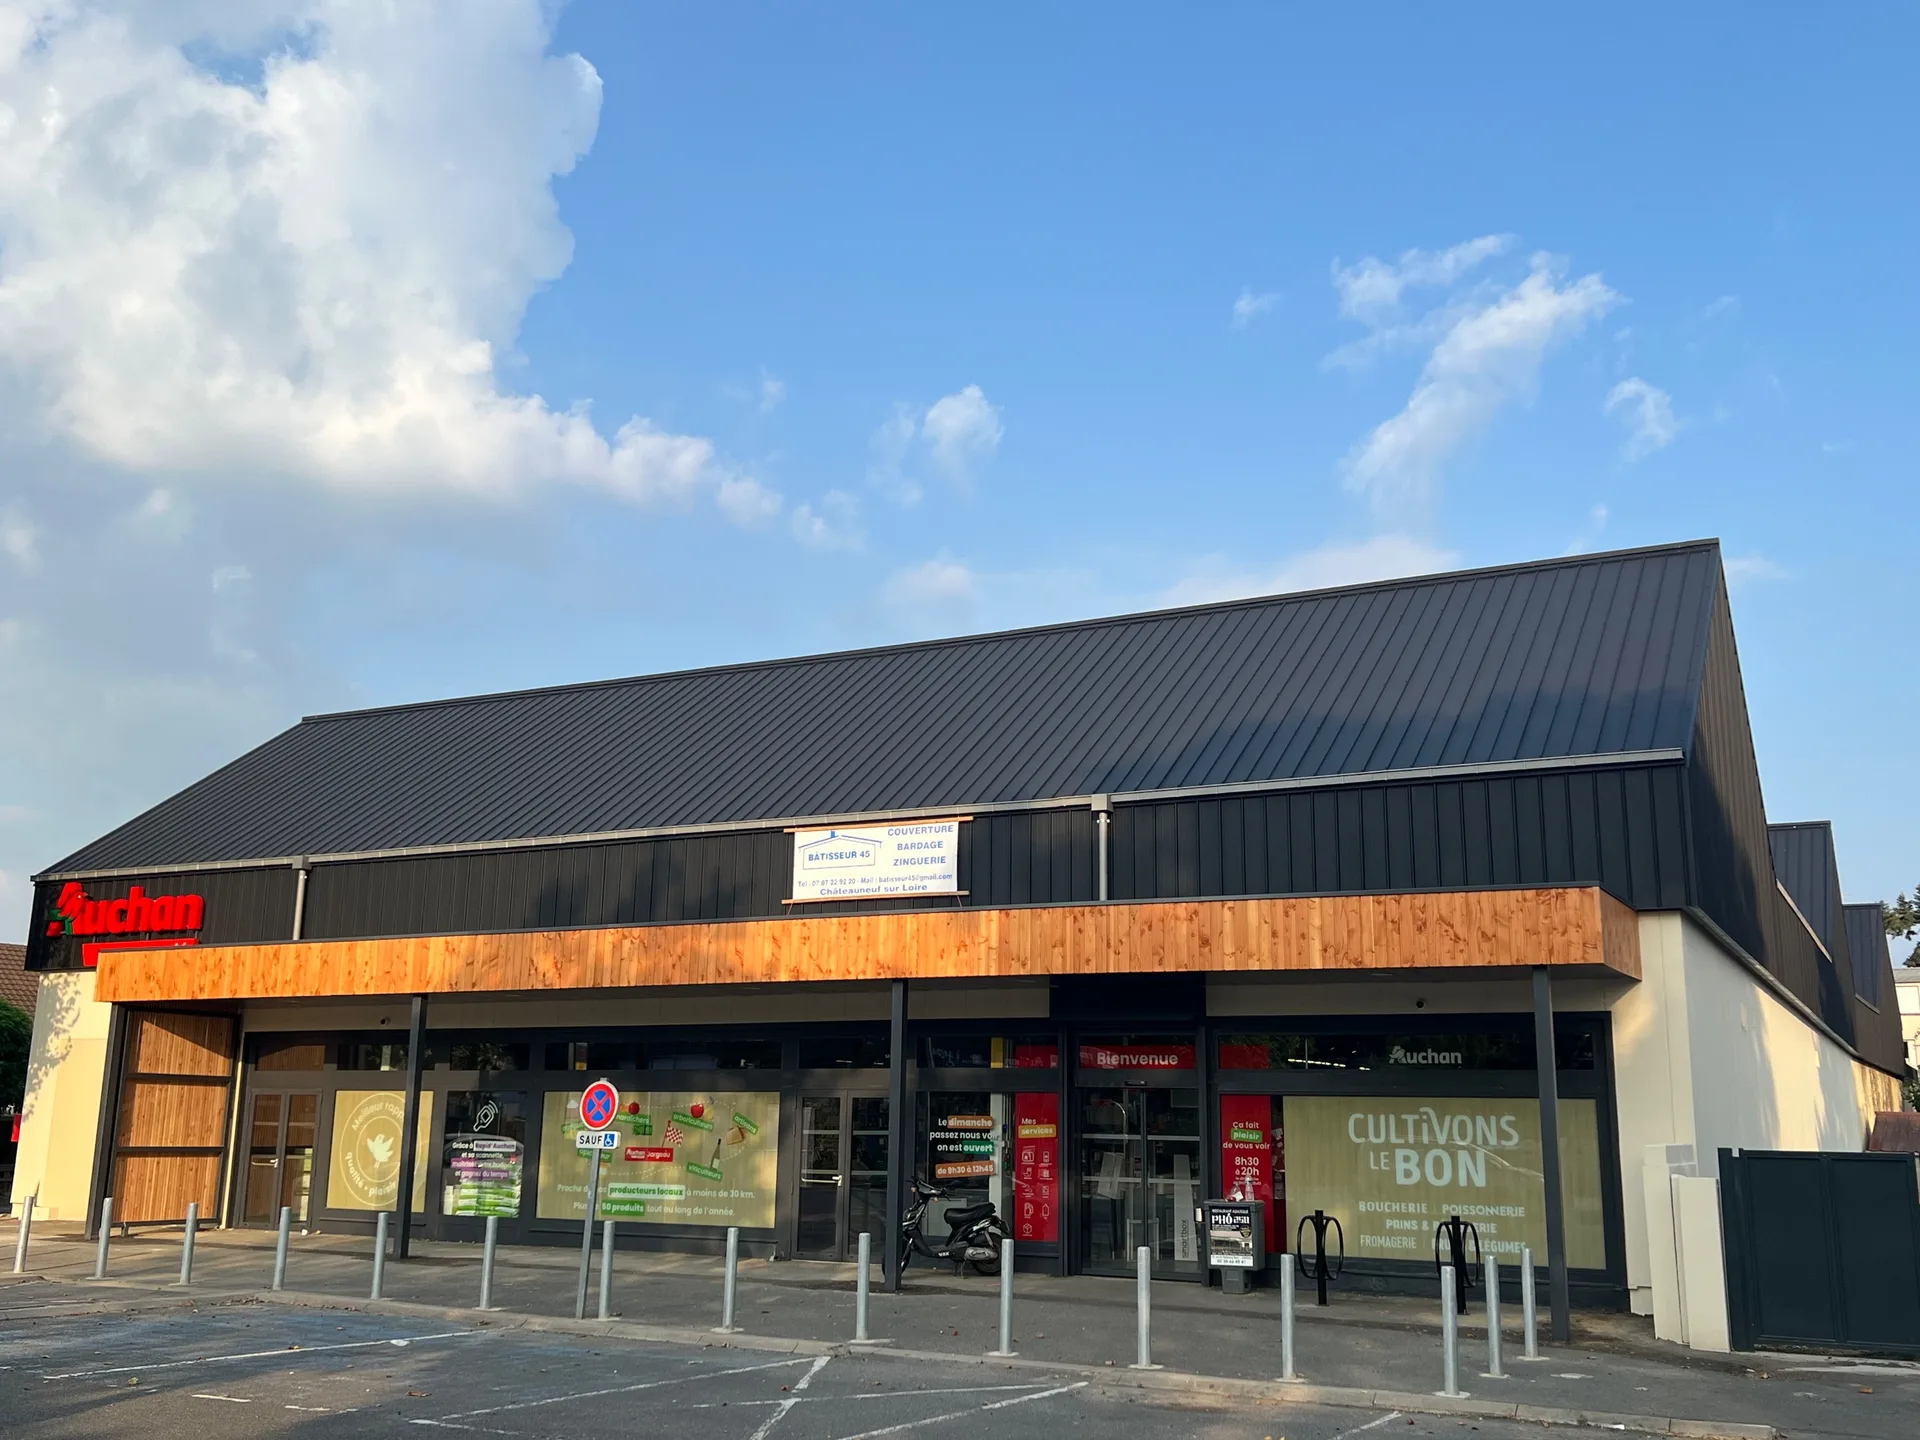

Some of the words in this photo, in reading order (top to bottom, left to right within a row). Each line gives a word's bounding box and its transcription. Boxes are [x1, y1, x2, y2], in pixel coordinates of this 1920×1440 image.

[888, 824, 954, 836] COUVERTURE
[897, 840, 944, 850] BARDAGE
[808, 850, 857, 862] BÂTISSEUR
[860, 850, 870, 859] 45
[893, 856, 946, 866] ZINGUERIE
[820, 886, 881, 896] Châteauneuf
[902, 884, 928, 892] Loire
[47, 882, 203, 937] Auchan
[1096, 1052, 1178, 1066] Bienvenue
[1389, 1046, 1462, 1065] Auchan
[673, 1113, 712, 1130] arboriculteurs
[734, 1116, 756, 1134] artisans
[938, 1118, 948, 1126] Le
[949, 1118, 992, 1126] dimanche
[1232, 1122, 1244, 1130] Ça
[930, 1132, 958, 1140] passez
[1022, 1127, 1053, 1135] services
[1234, 1132, 1260, 1140] plaisir
[580, 1135, 602, 1144] SAUF
[949, 1144, 962, 1152] est
[1234, 1156, 1260, 1166] 8h30
[345, 1152, 365, 1188] qualité
[688, 1164, 721, 1179] viticulteurs
[972, 1164, 994, 1172] 12h45
[1241, 1166, 1260, 1176] 20h
[1370, 1152, 1390, 1170] LE
[1394, 1148, 1487, 1188] BON
[558, 1184, 582, 1192] Proche
[610, 1186, 656, 1196] producteurs
[657, 1187, 684, 1196] locaux
[693, 1188, 716, 1197] moins
[718, 1190, 728, 1198] de
[740, 1190, 756, 1198] km.
[612, 1203, 644, 1213] produits
[675, 1206, 692, 1216] long
[704, 1206, 736, 1216] l'année.
[1359, 1200, 1428, 1214] BOUCHERIE
[1442, 1204, 1526, 1217] POISSONNERIE
[1386, 1219, 1418, 1230] PAINS
[1422, 1220, 1430, 1231] &
[1360, 1234, 1417, 1250] FROMAGERIE
